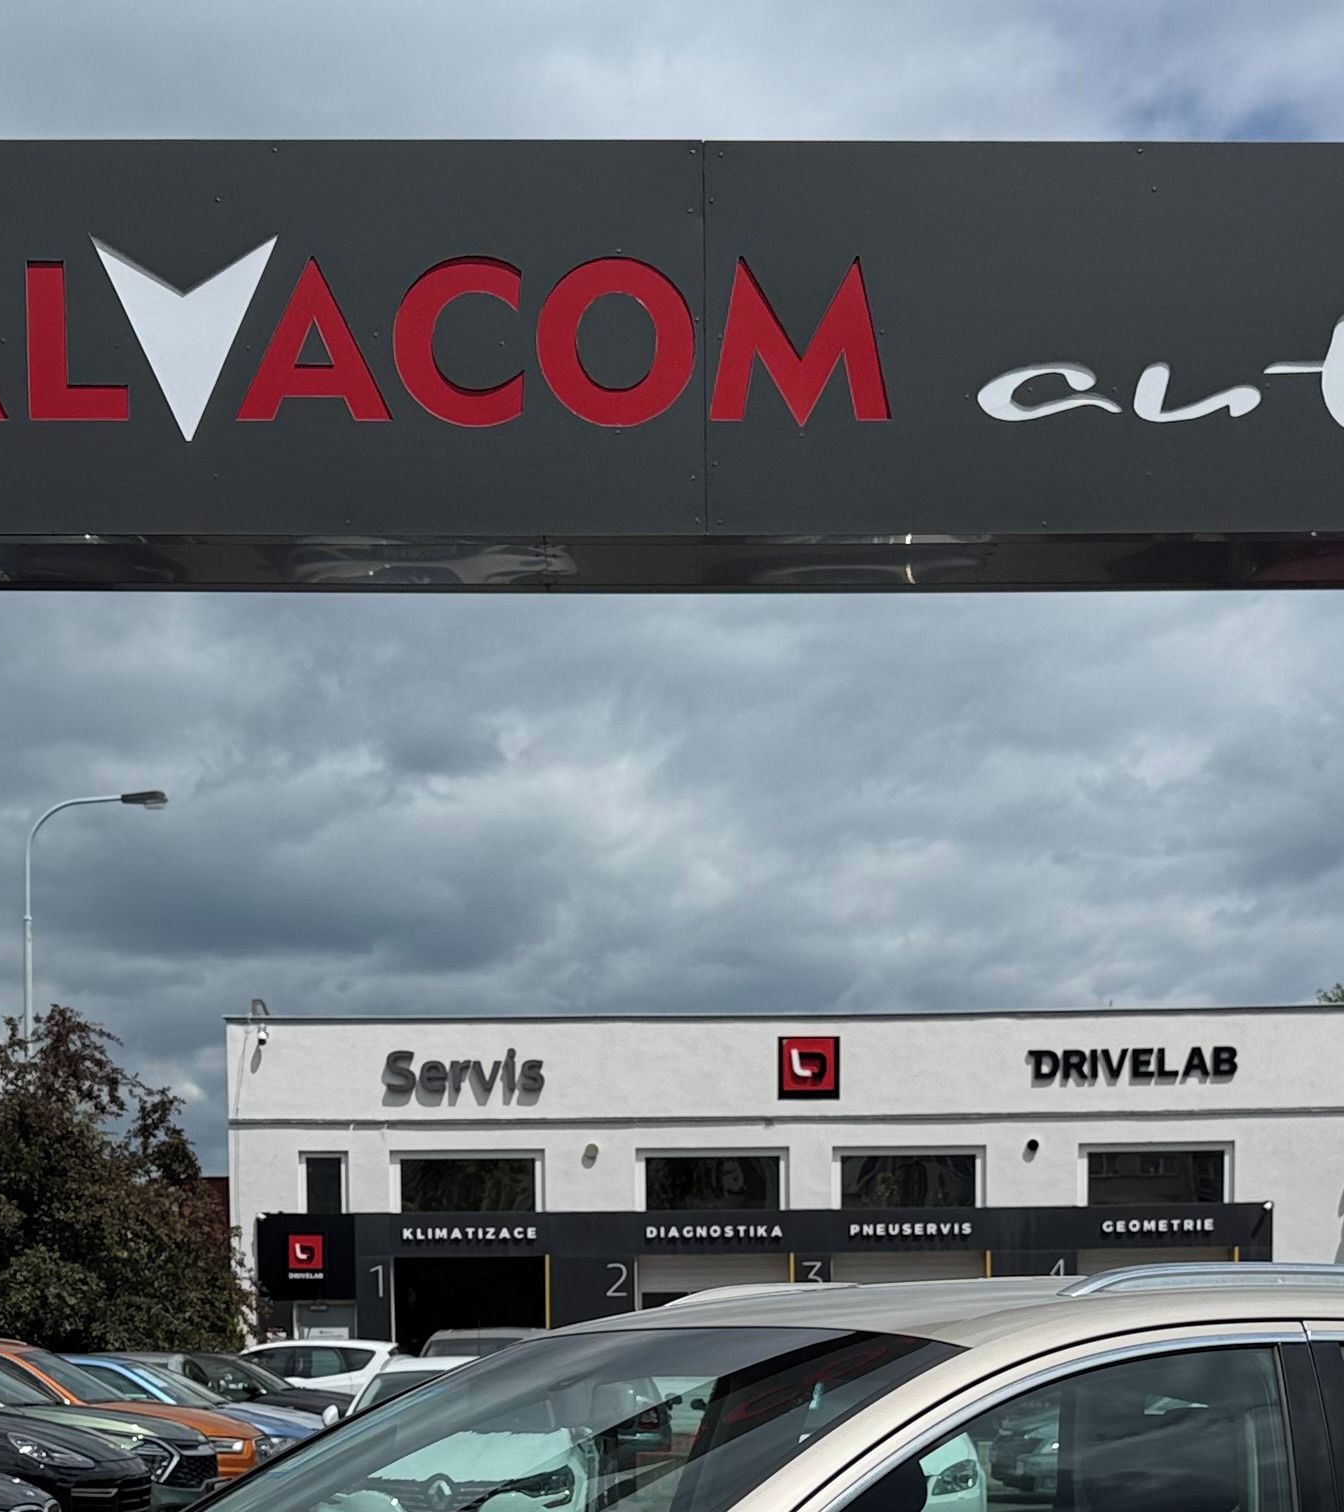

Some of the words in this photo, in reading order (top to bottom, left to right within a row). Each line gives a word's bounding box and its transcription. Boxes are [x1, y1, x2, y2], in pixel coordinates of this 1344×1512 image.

[382, 1048, 545, 1095] Servis
[1027, 1046, 1238, 1081] DRIVELAB
[402, 1227, 537, 1240] KLIMATIZACE
[646, 1225, 783, 1238] DIAGNOSTIKA
[850, 1223, 972, 1236] PNEUSERVIS
[1102, 1218, 1214, 1232] GEOMETRIE
[369, 1264, 384, 1298] 1
[606, 1263, 628, 1296] 2
